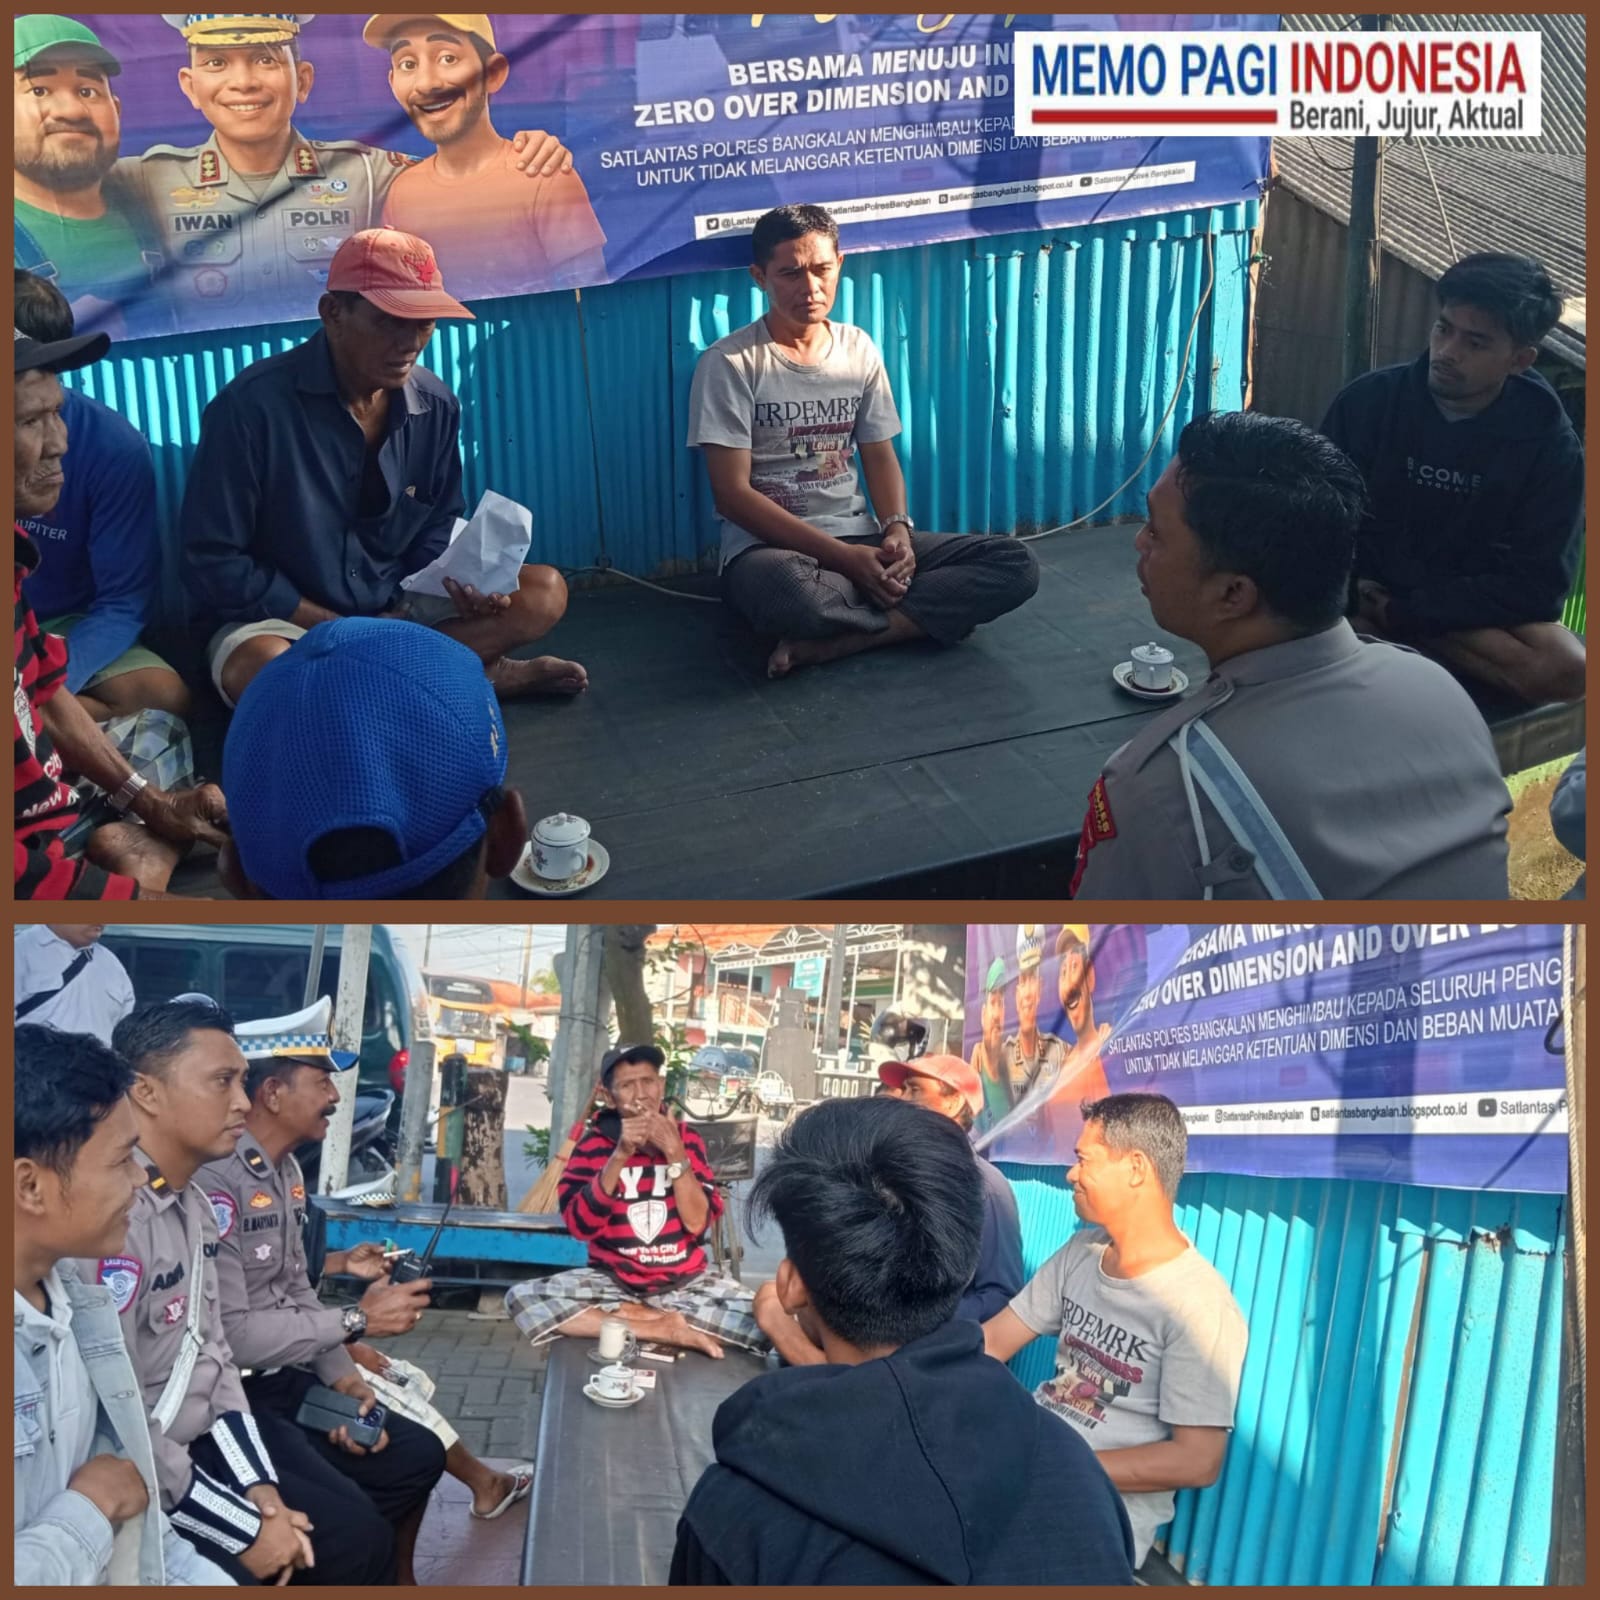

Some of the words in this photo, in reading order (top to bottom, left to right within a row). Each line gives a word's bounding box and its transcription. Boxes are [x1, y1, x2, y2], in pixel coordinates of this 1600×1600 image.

[728, 54, 863, 86] BERSAMA
[872, 45, 976, 75] MENUJU
[985, 43, 1014, 66] IN
[633, 98, 714, 127] ZERO
[724, 91, 798, 119] OVER
[806, 79, 950, 113] DIMENSION
[958, 74, 1009, 100] AND
[601, 144, 698, 168] SATLANTAS
[703, 137, 768, 159] POLRES
[773, 129, 866, 152] BANGKALAN
[870, 119, 971, 142] MENGHIMBAU
[636, 166, 695, 187] UNTUK
[699, 162, 747, 180] TIDAK
[751, 151, 850, 175] MELANGGAR
[854, 144, 944, 166] KETENTUAN
[948, 136, 1006, 157] DIMENSI
[1009, 136, 1038, 151] DAN
[175, 214, 233, 231] IWAN
[291, 210, 349, 226] POLRI
[1161, 968, 1204, 1005] OVER
[1208, 940, 1324, 995] DIMENSION
[1331, 925, 1383, 968] AND
[1108, 1033, 1152, 1055] SATLANTAS
[1154, 1027, 1191, 1048] POLRES
[1192, 1013, 1256, 1041] BANGKALAN
[1258, 997, 1344, 1031] MENGHIMBAU
[1346, 986, 1407, 1017] KEPADA
[1410, 969, 1495, 1006] SELURUH
[1502, 959, 1568, 993] PENG
[1125, 1056, 1154, 1076] UNTUK
[1154, 1053, 1181, 1072] TIDAK
[1182, 1047, 1244, 1068] MELANGGAR
[1246, 1031, 1316, 1059] KETENTUAN
[1320, 1022, 1379, 1051] DIMENSI
[1384, 1017, 1418, 1044] DAN
[1423, 1006, 1484, 1039] BEBAN
[1490, 996, 1565, 1032] MUATA
[1321, 1102, 1468, 1122] satlantasbangkalan.blogspot.co.id
[1500, 1101, 1555, 1115] Satlantas
